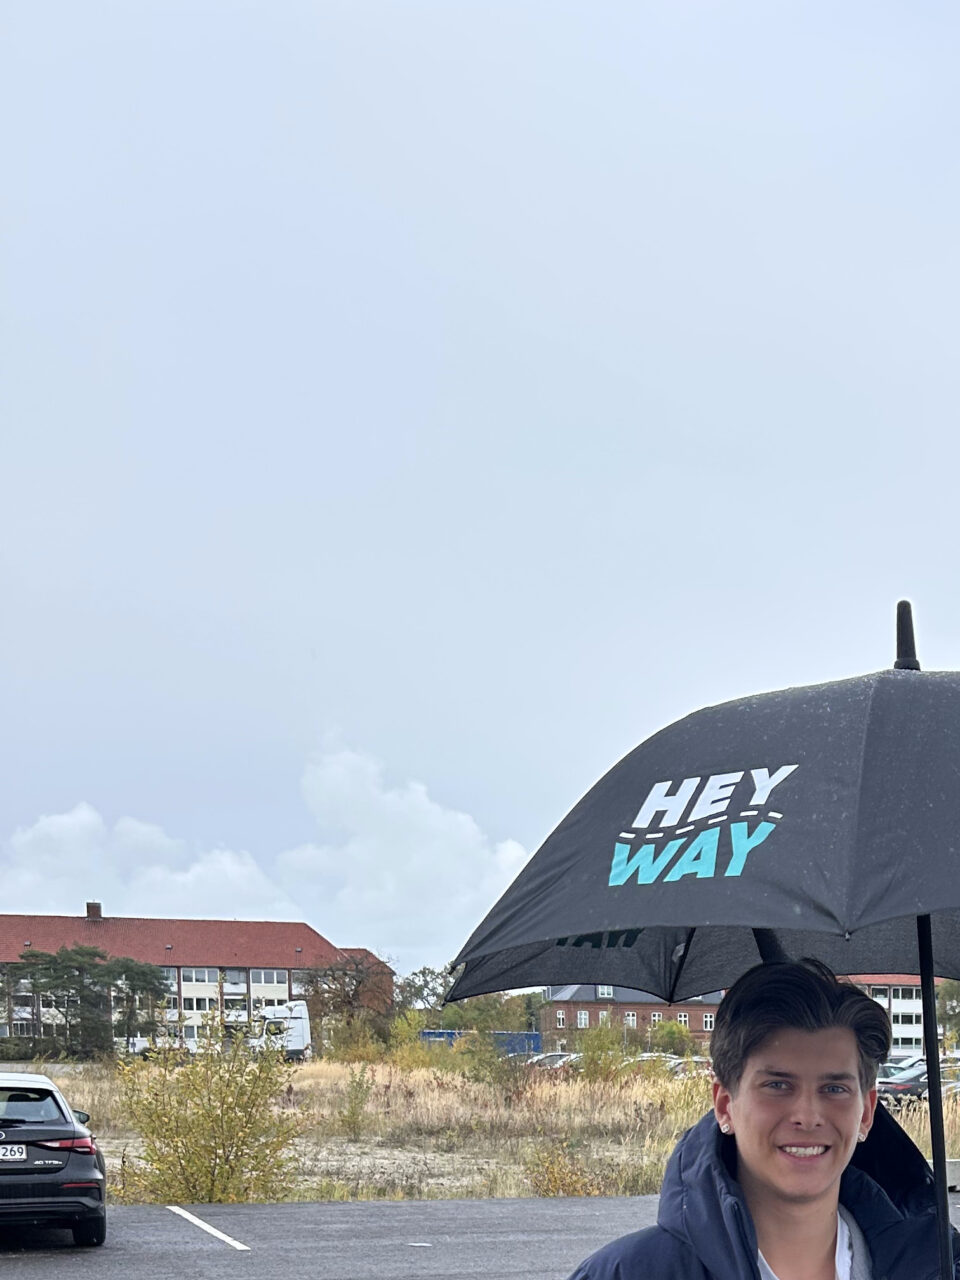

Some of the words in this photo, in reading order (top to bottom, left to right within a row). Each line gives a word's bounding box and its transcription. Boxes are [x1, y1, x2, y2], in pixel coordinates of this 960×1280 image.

[631, 764, 800, 829] HEY
[608, 821, 777, 887] WAY
[1, 1146, 24, 1157] 269
